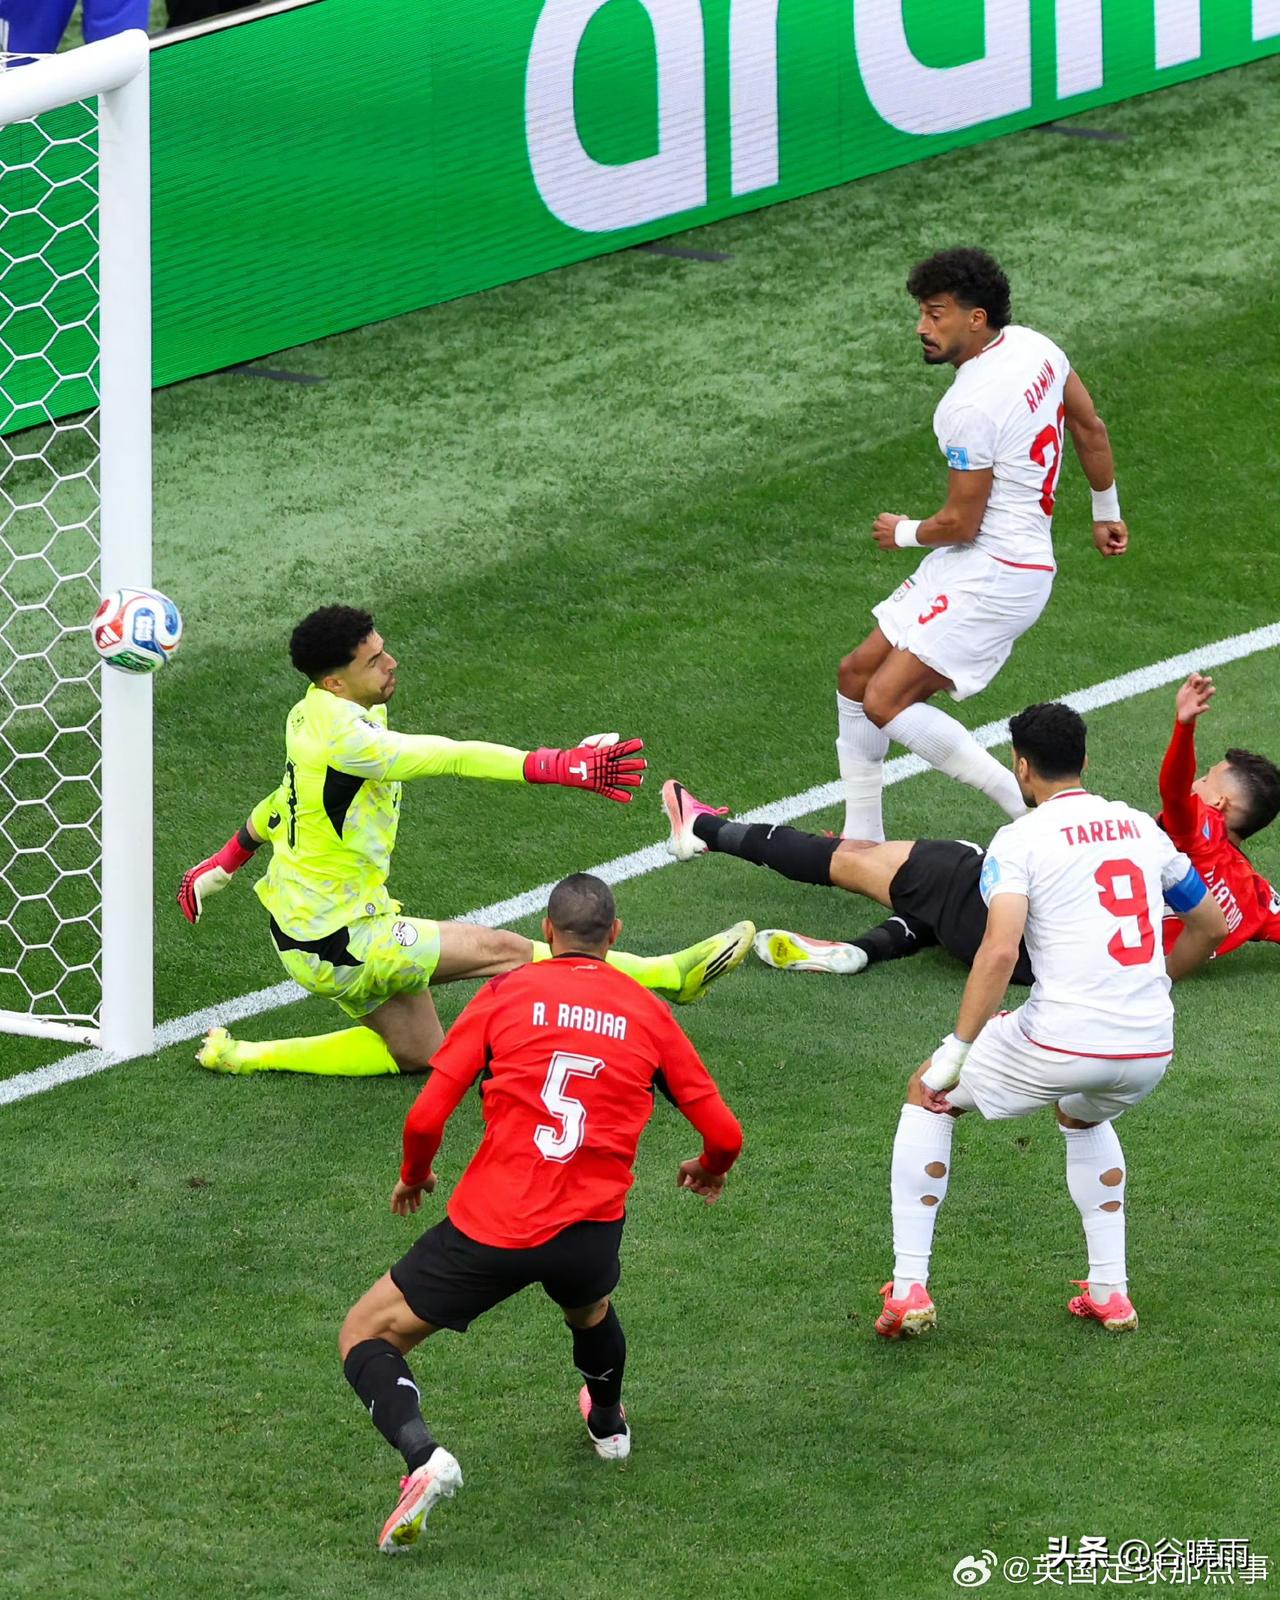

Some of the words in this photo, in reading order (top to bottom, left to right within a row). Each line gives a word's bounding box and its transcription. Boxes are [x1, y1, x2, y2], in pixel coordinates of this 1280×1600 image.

[1023, 358, 1056, 414] RAMIN
[1060, 819, 1142, 846] TAREMI
[1093, 858, 1156, 967] 9
[532, 1001, 549, 1026] A.
[557, 1003, 627, 1041] RABIAA
[533, 1050, 606, 1164] 5
